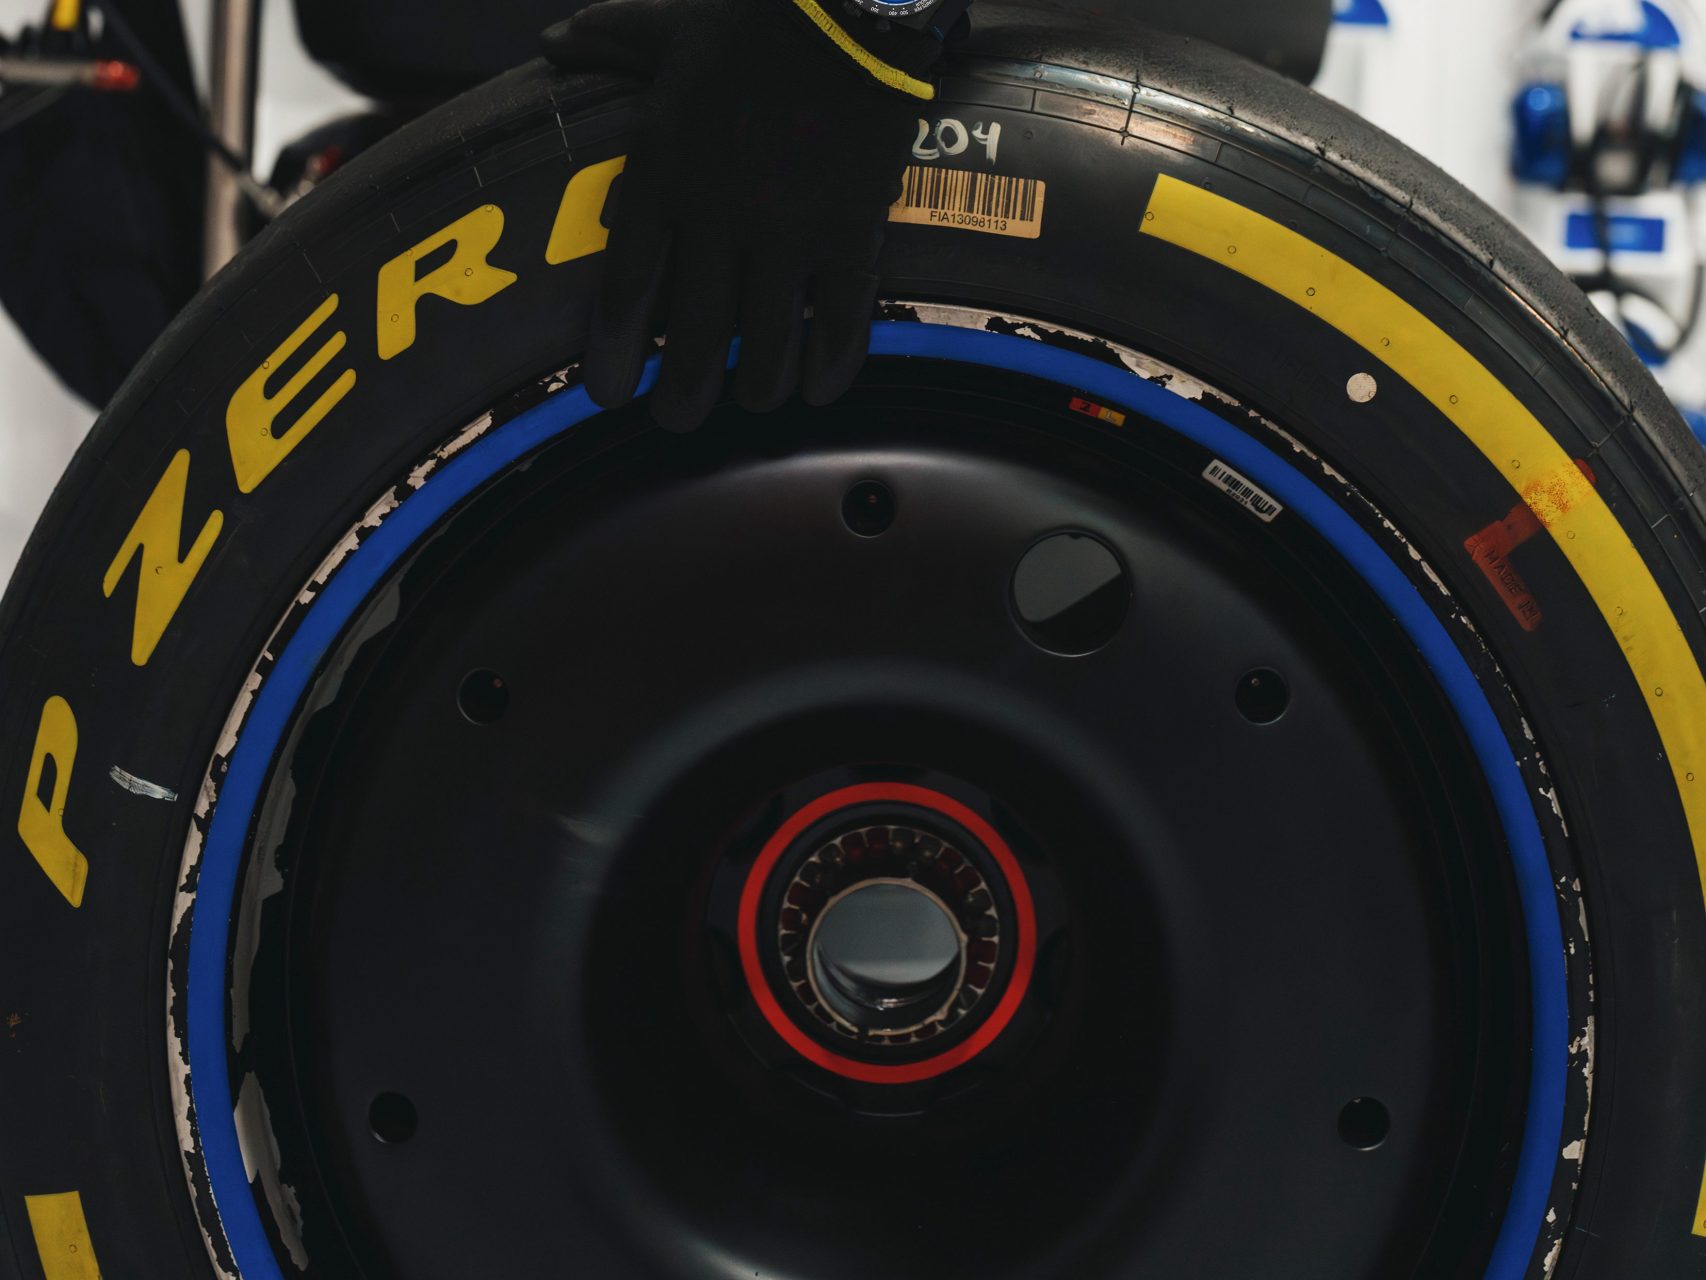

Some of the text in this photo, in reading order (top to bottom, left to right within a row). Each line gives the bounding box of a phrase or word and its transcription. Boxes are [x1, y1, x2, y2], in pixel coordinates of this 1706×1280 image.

[911, 118, 1001, 166] 204
[930, 210, 1008, 231] FIA13098113
[1484, 548, 1525, 595] MADE
[17, 696, 89, 908] P
